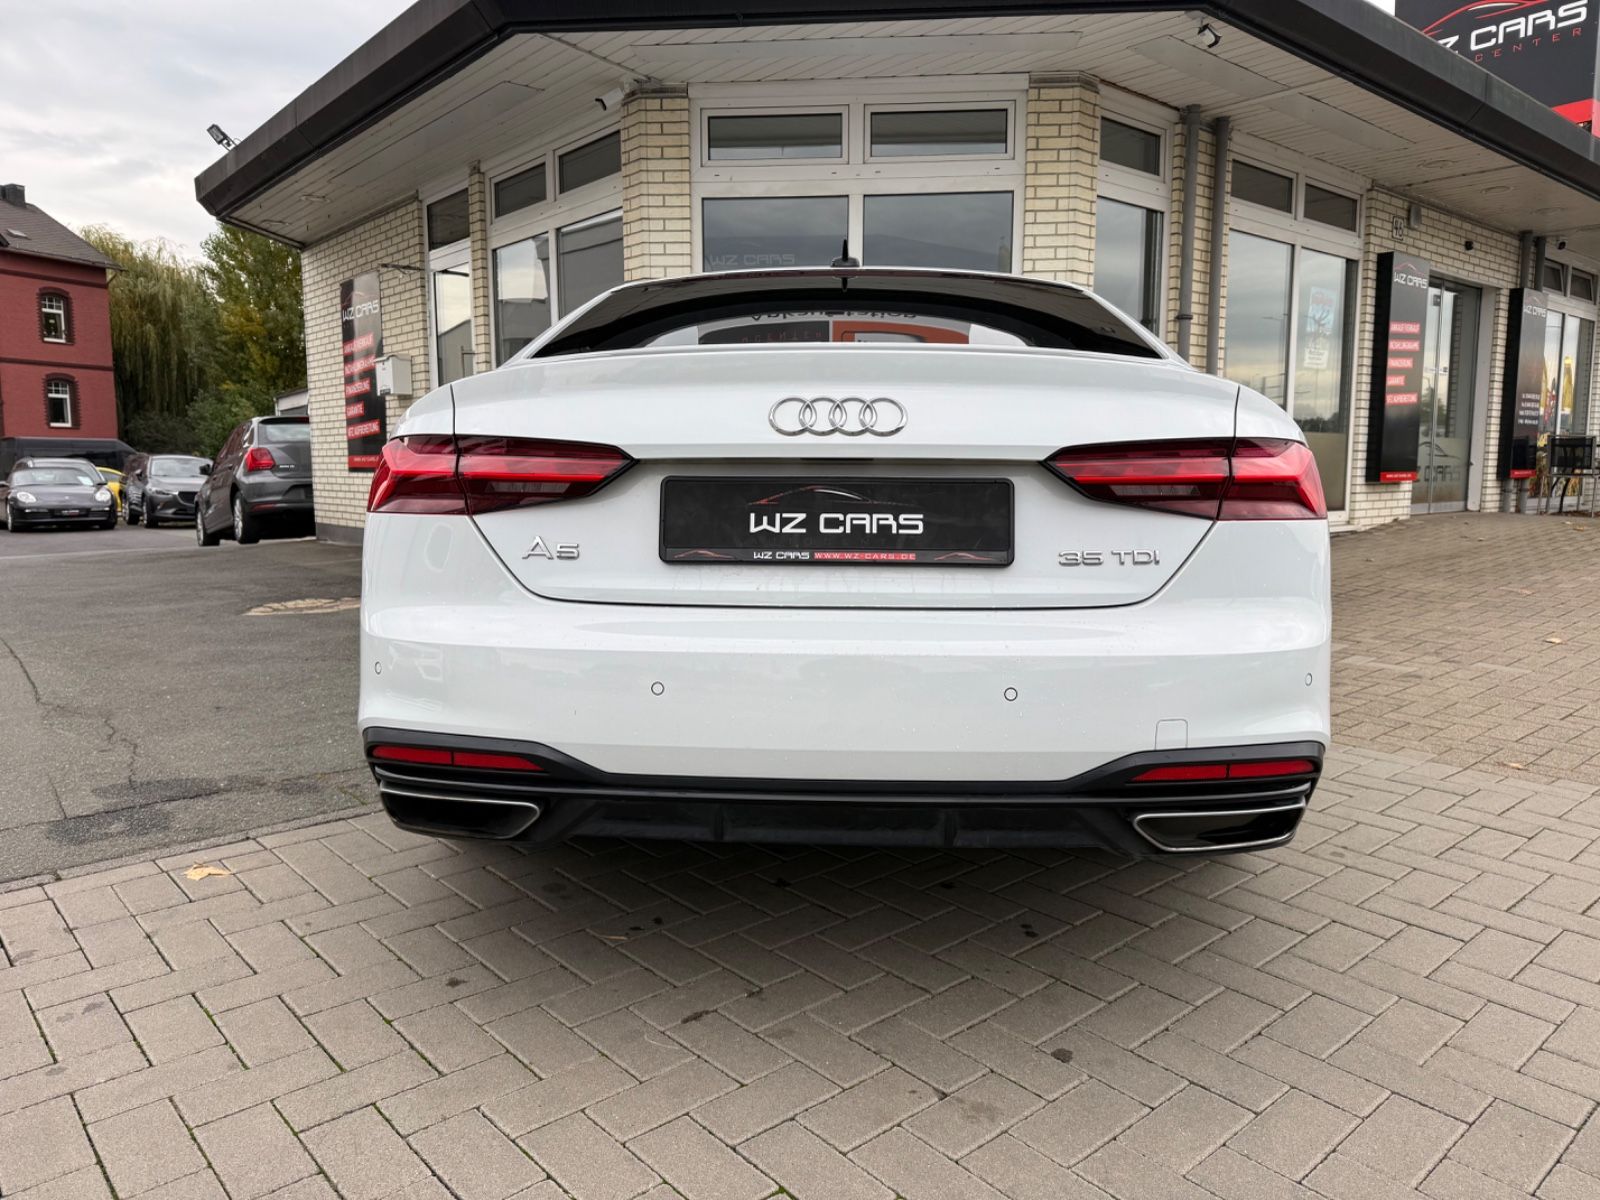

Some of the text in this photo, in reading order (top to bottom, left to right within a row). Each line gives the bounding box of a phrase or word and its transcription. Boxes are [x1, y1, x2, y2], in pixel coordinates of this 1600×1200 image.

[1469, 0, 1589, 51] CARS
[1474, 27, 1583, 62] CENTER
[710, 253, 796, 266] WZ CARS
[1394, 271, 1428, 289] WZ CARS
[342, 299, 379, 323] WZ CARS
[749, 512, 924, 534] WZ CARS
[521, 535, 580, 561] A5
[753, 551, 773, 560] WZ
[775, 551, 810, 560] CARS
[1058, 549, 1161, 567] 35 TDI
